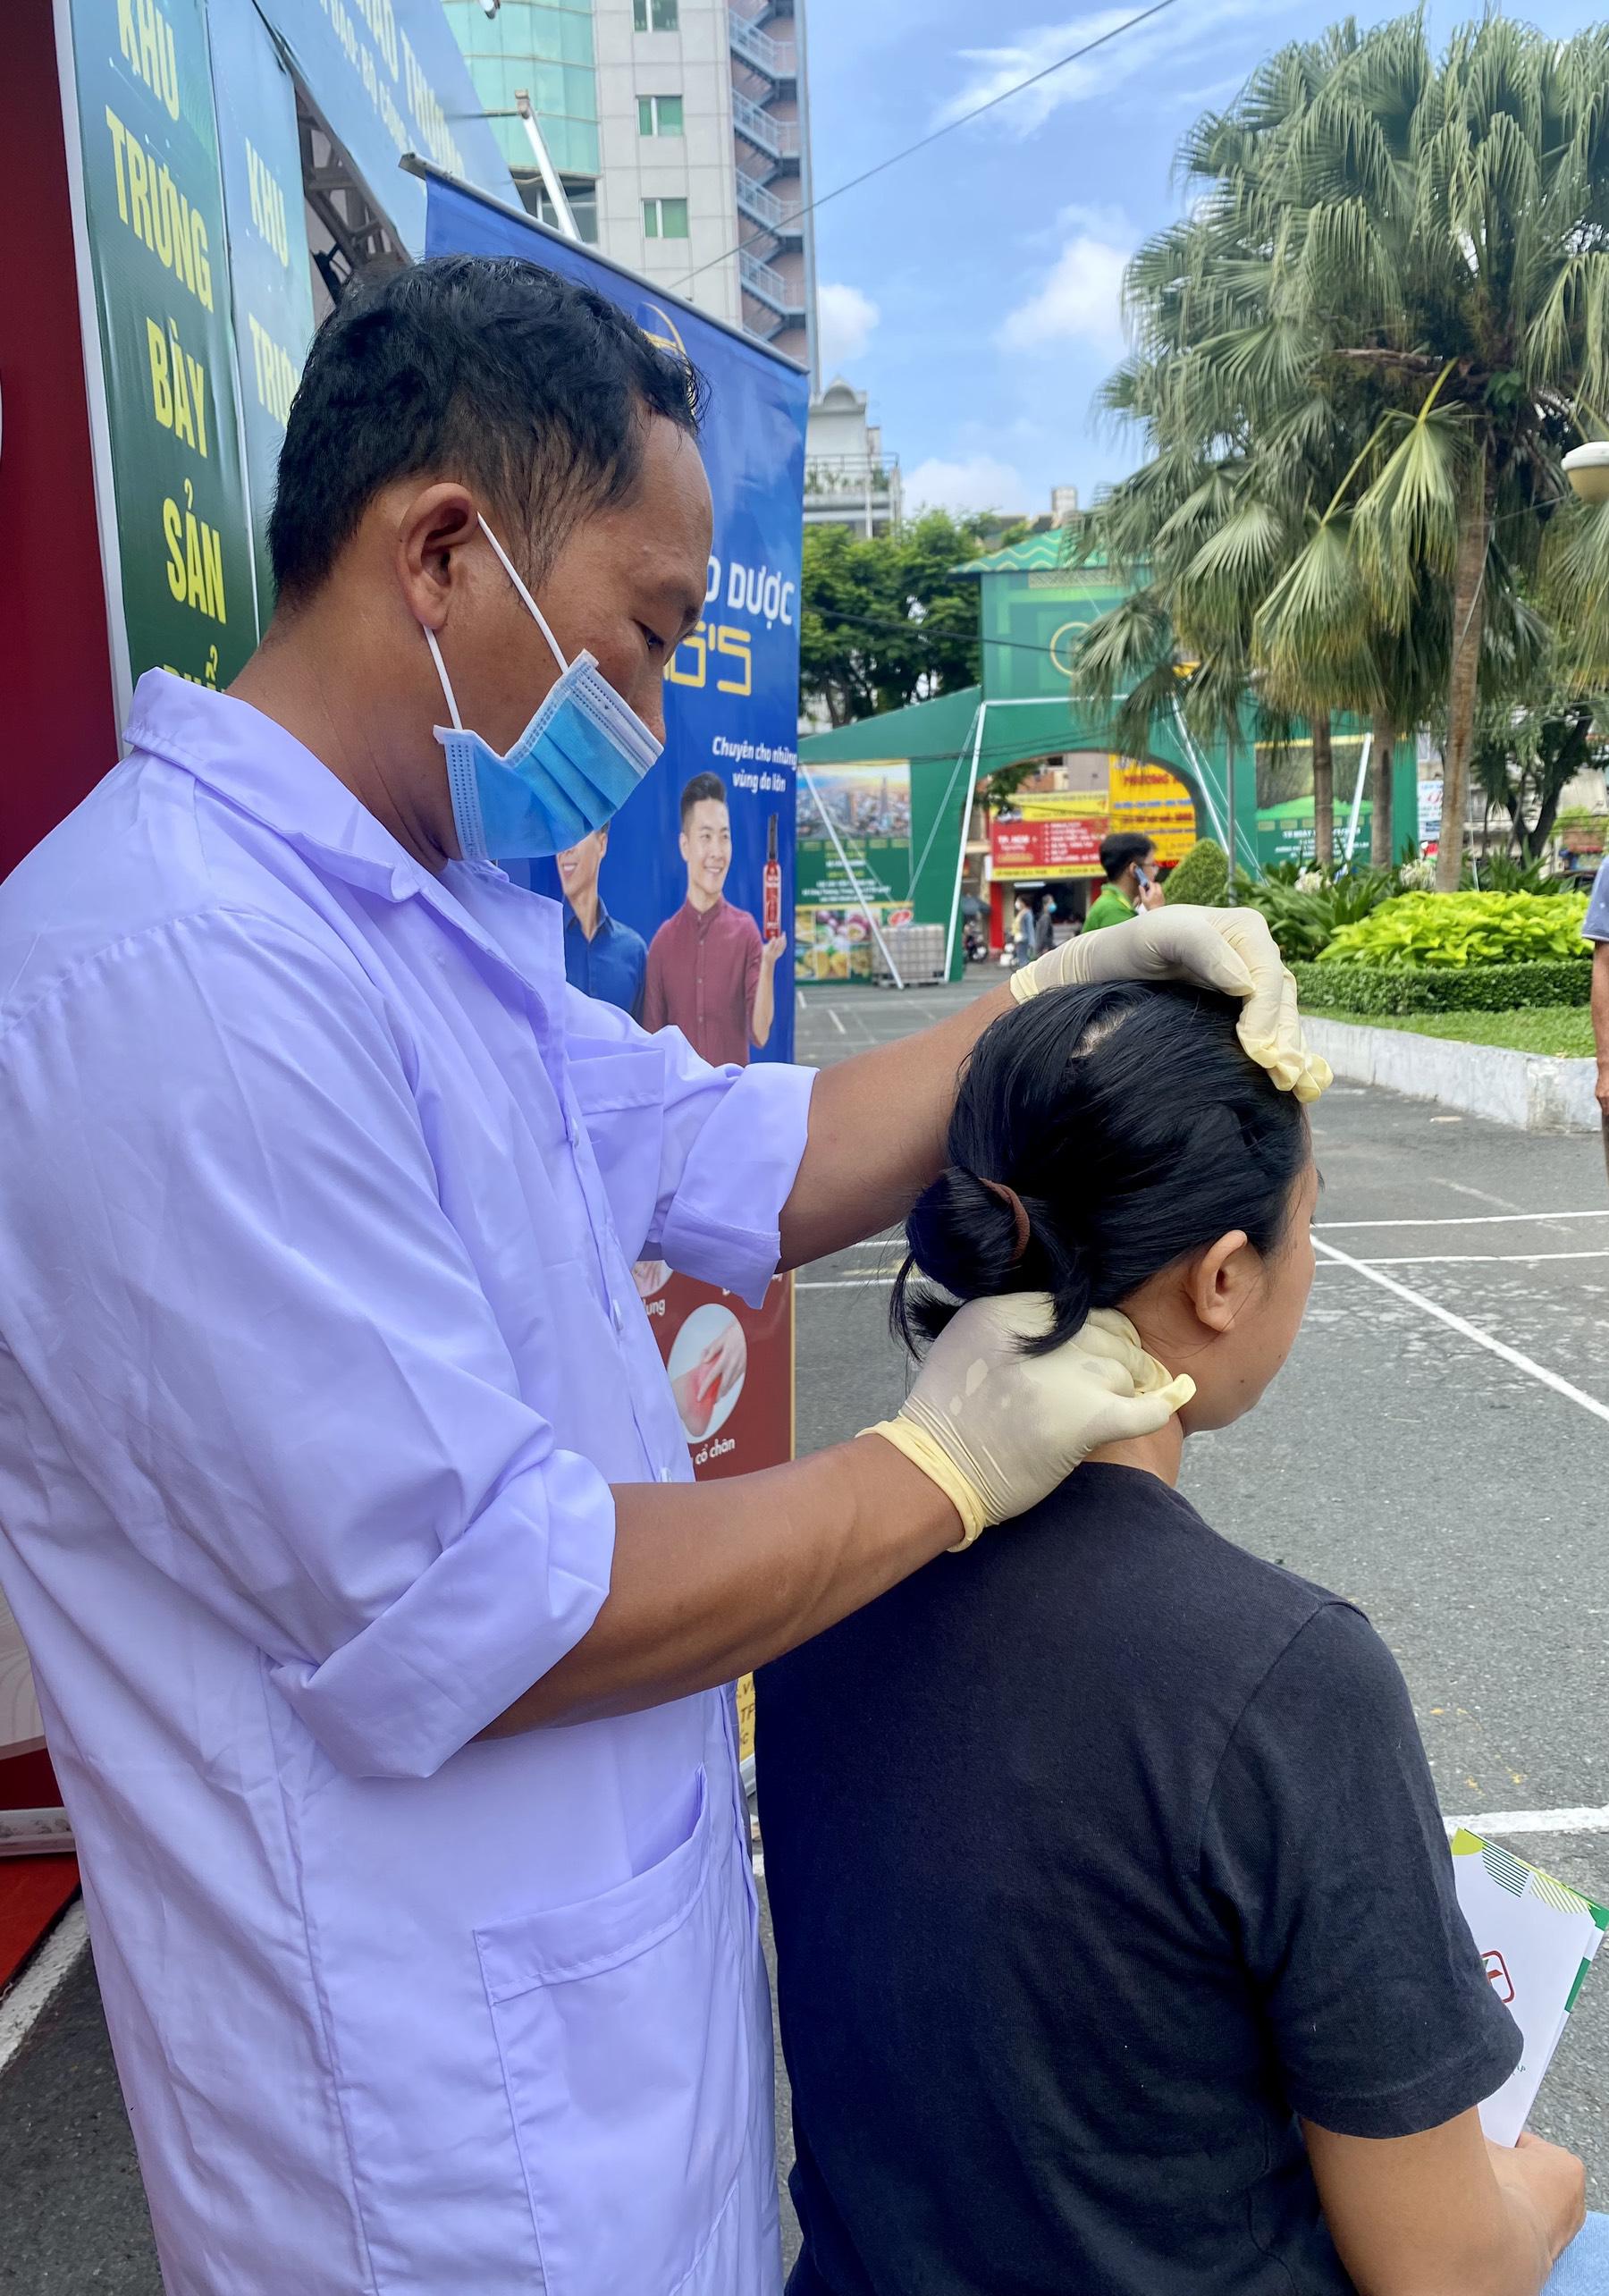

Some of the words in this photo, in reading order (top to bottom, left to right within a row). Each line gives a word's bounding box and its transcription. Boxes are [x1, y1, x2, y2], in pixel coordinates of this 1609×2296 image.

[117, 0, 180, 122] KHU
[105, 104, 215, 314] TRƯNG
[245, 136, 290, 268] KHU
[146, 316, 208, 459] BÀY
[162, 477, 227, 625] SẢN
[727, 565, 796, 630] DƯỢC
[712, 736, 754, 763] Chuyên
[754, 742, 772, 763] cho
[732, 768, 759, 794] vùng
[709, 1438, 736, 1459] chân
